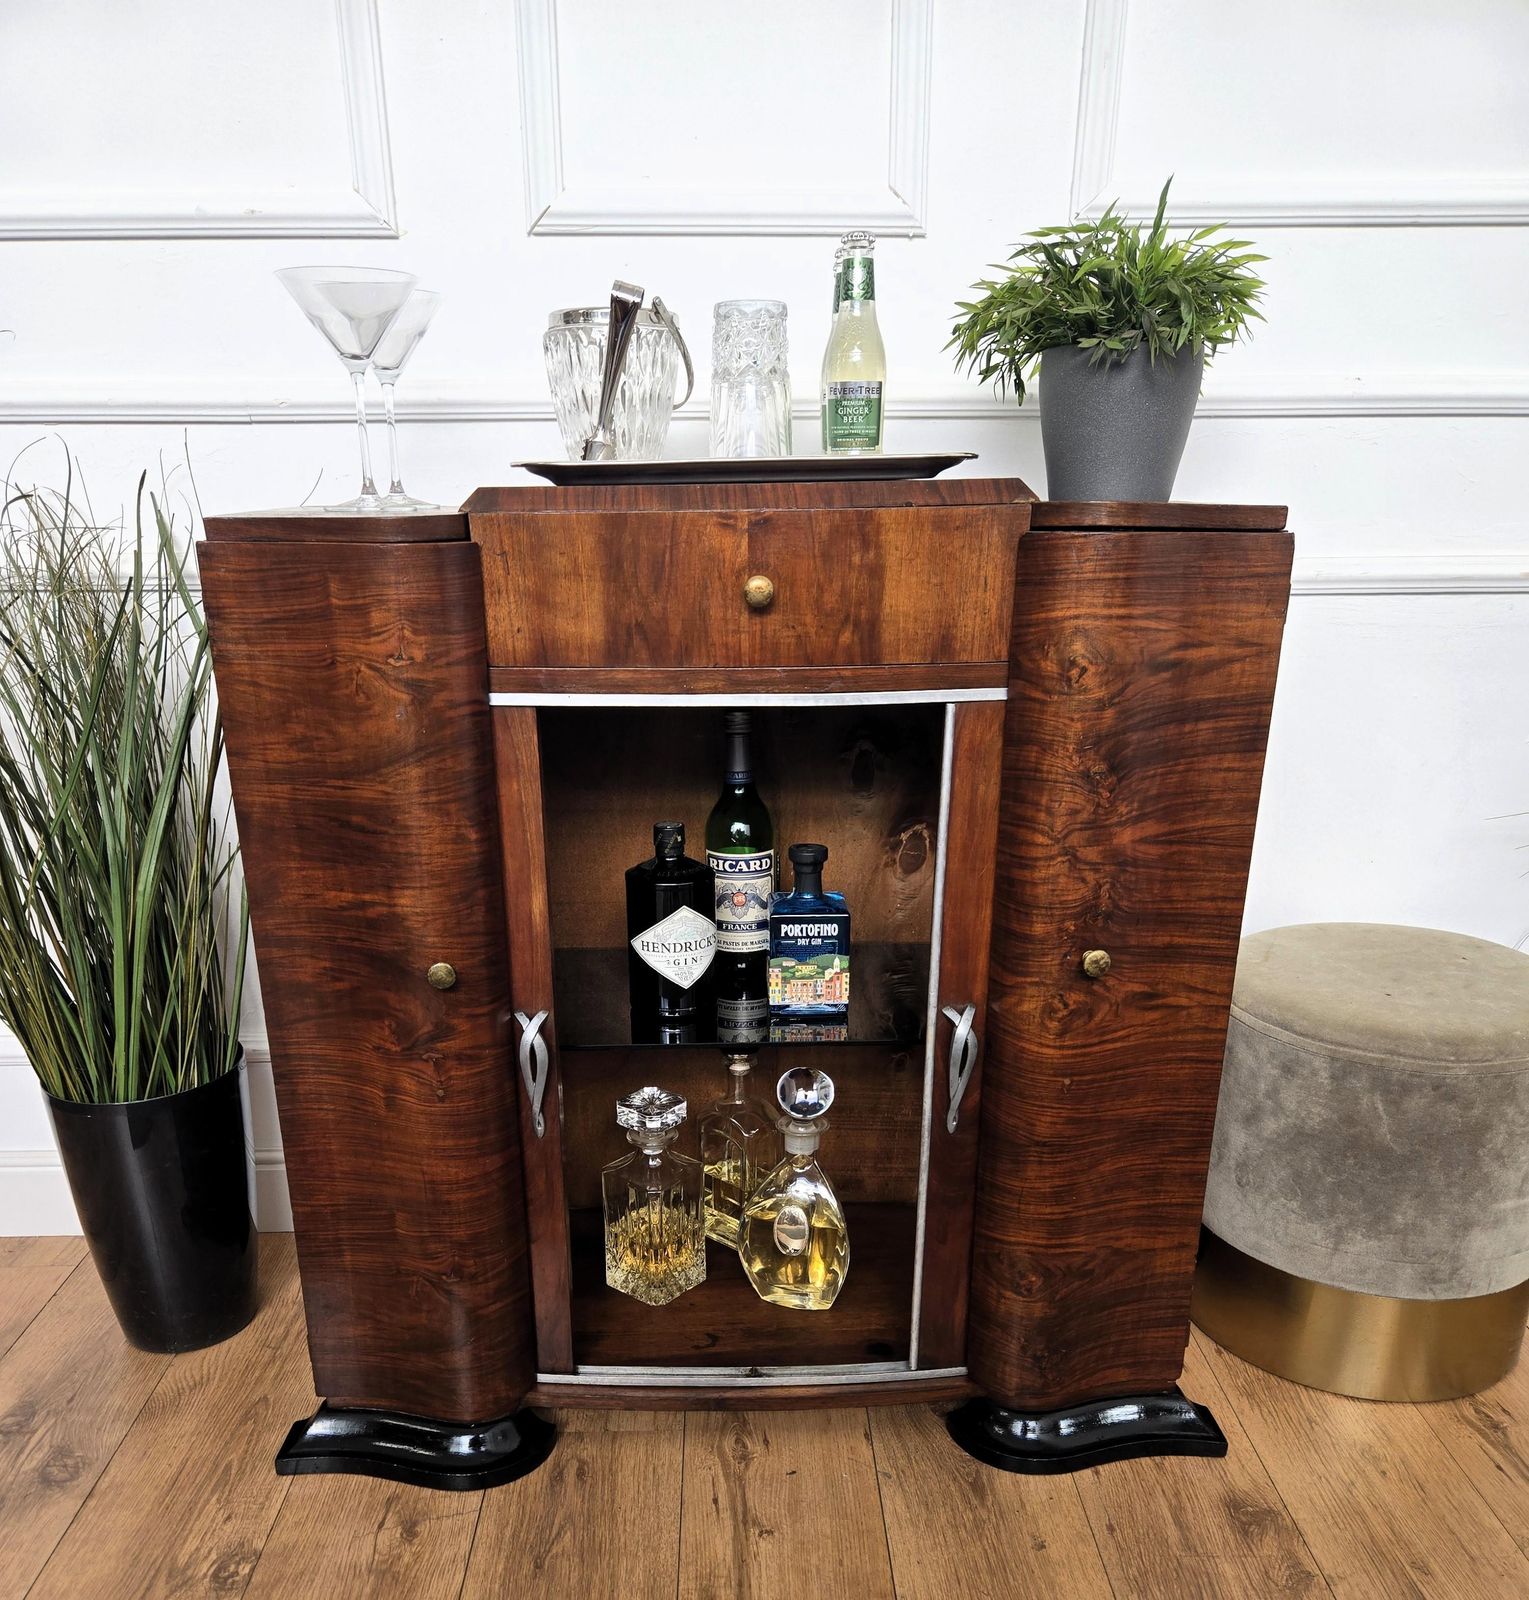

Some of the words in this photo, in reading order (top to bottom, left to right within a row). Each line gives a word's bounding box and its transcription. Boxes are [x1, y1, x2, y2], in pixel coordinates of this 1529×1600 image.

[829, 386, 880, 395] FEVER-TREE
[837, 407, 869, 415] GINGER
[709, 857, 771, 872] RICARD
[722, 923, 757, 931] FRANCE
[780, 923, 839, 937] PORTOFINO
[797, 938, 810, 946] DRY
[673, 956, 698, 966] GIN
